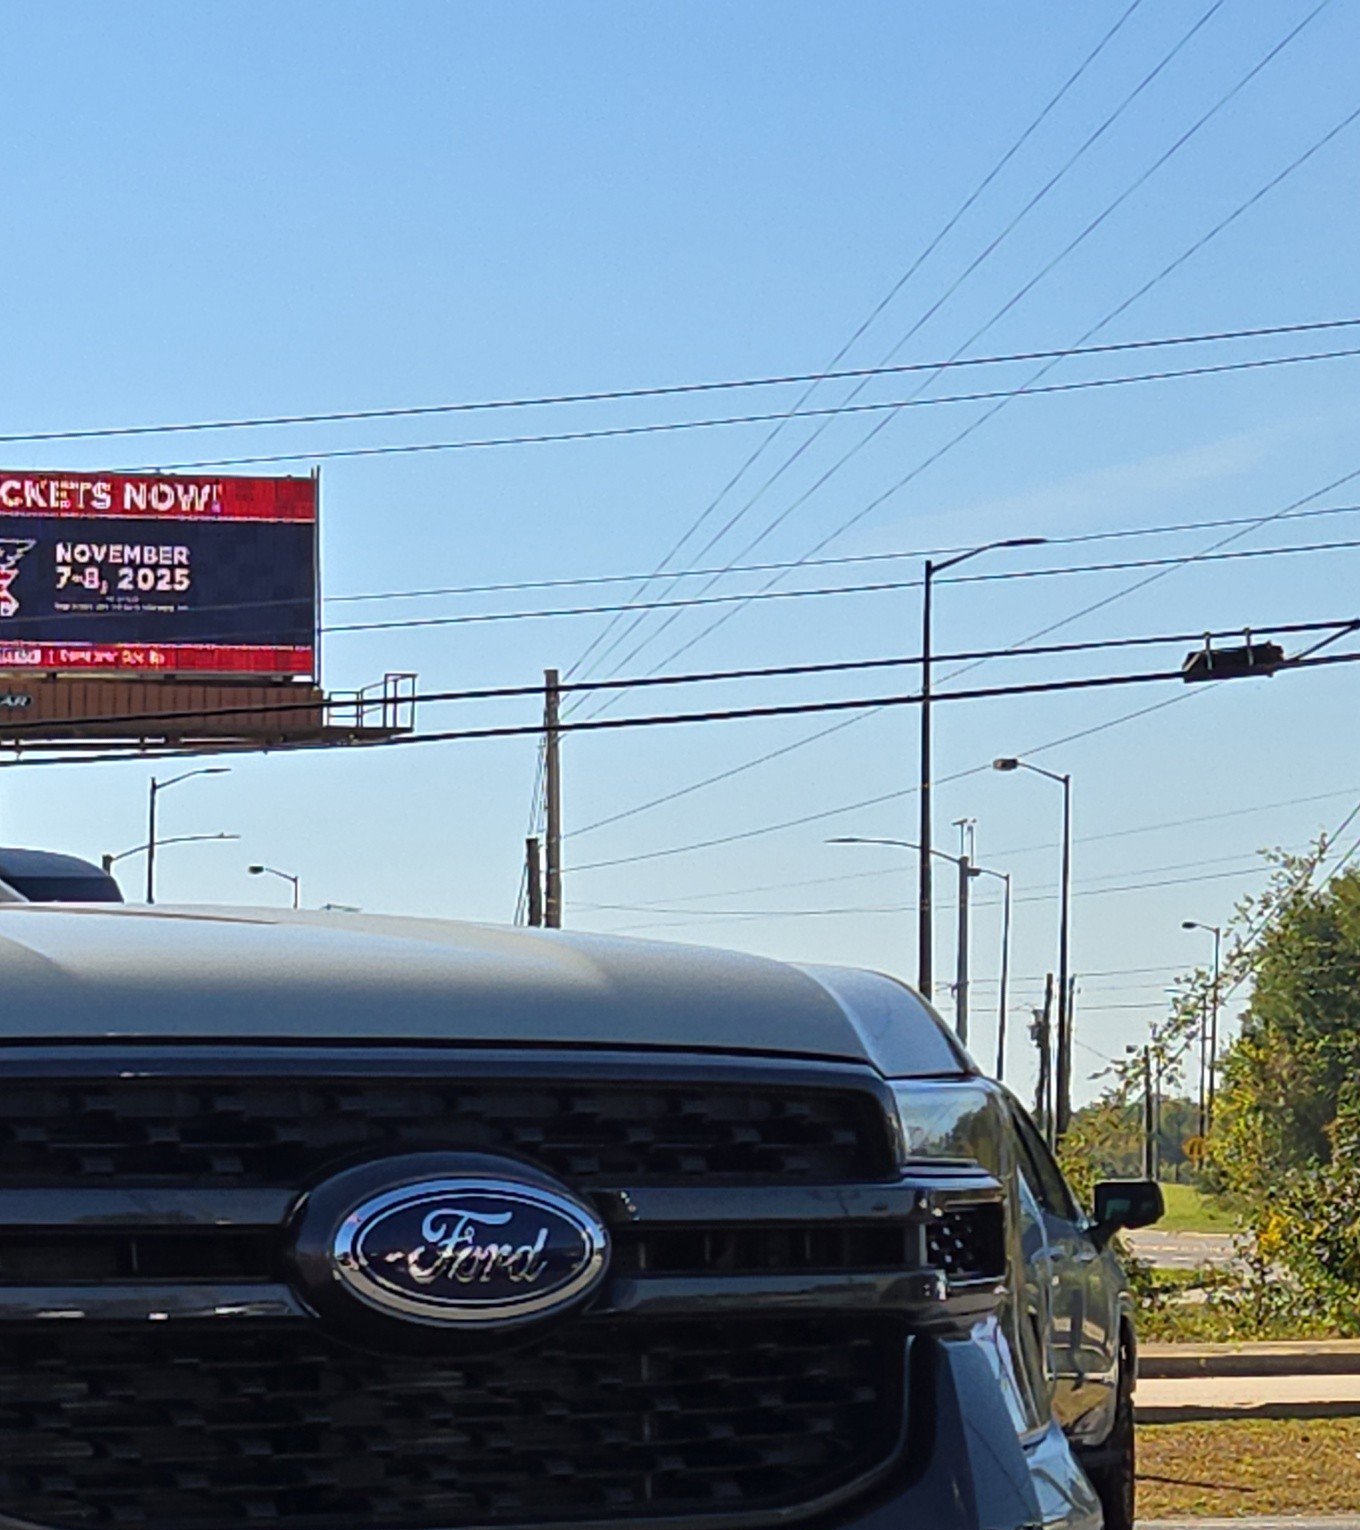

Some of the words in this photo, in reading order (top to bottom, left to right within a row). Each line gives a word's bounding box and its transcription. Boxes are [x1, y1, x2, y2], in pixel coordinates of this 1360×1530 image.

[123, 481, 223, 514] NOW!
[55, 542, 191, 565] NOVEMBER
[55, 565, 109, 595] 7-8,
[116, 567, 191, 592] 2025
[383, 1207, 549, 1284] Ford
